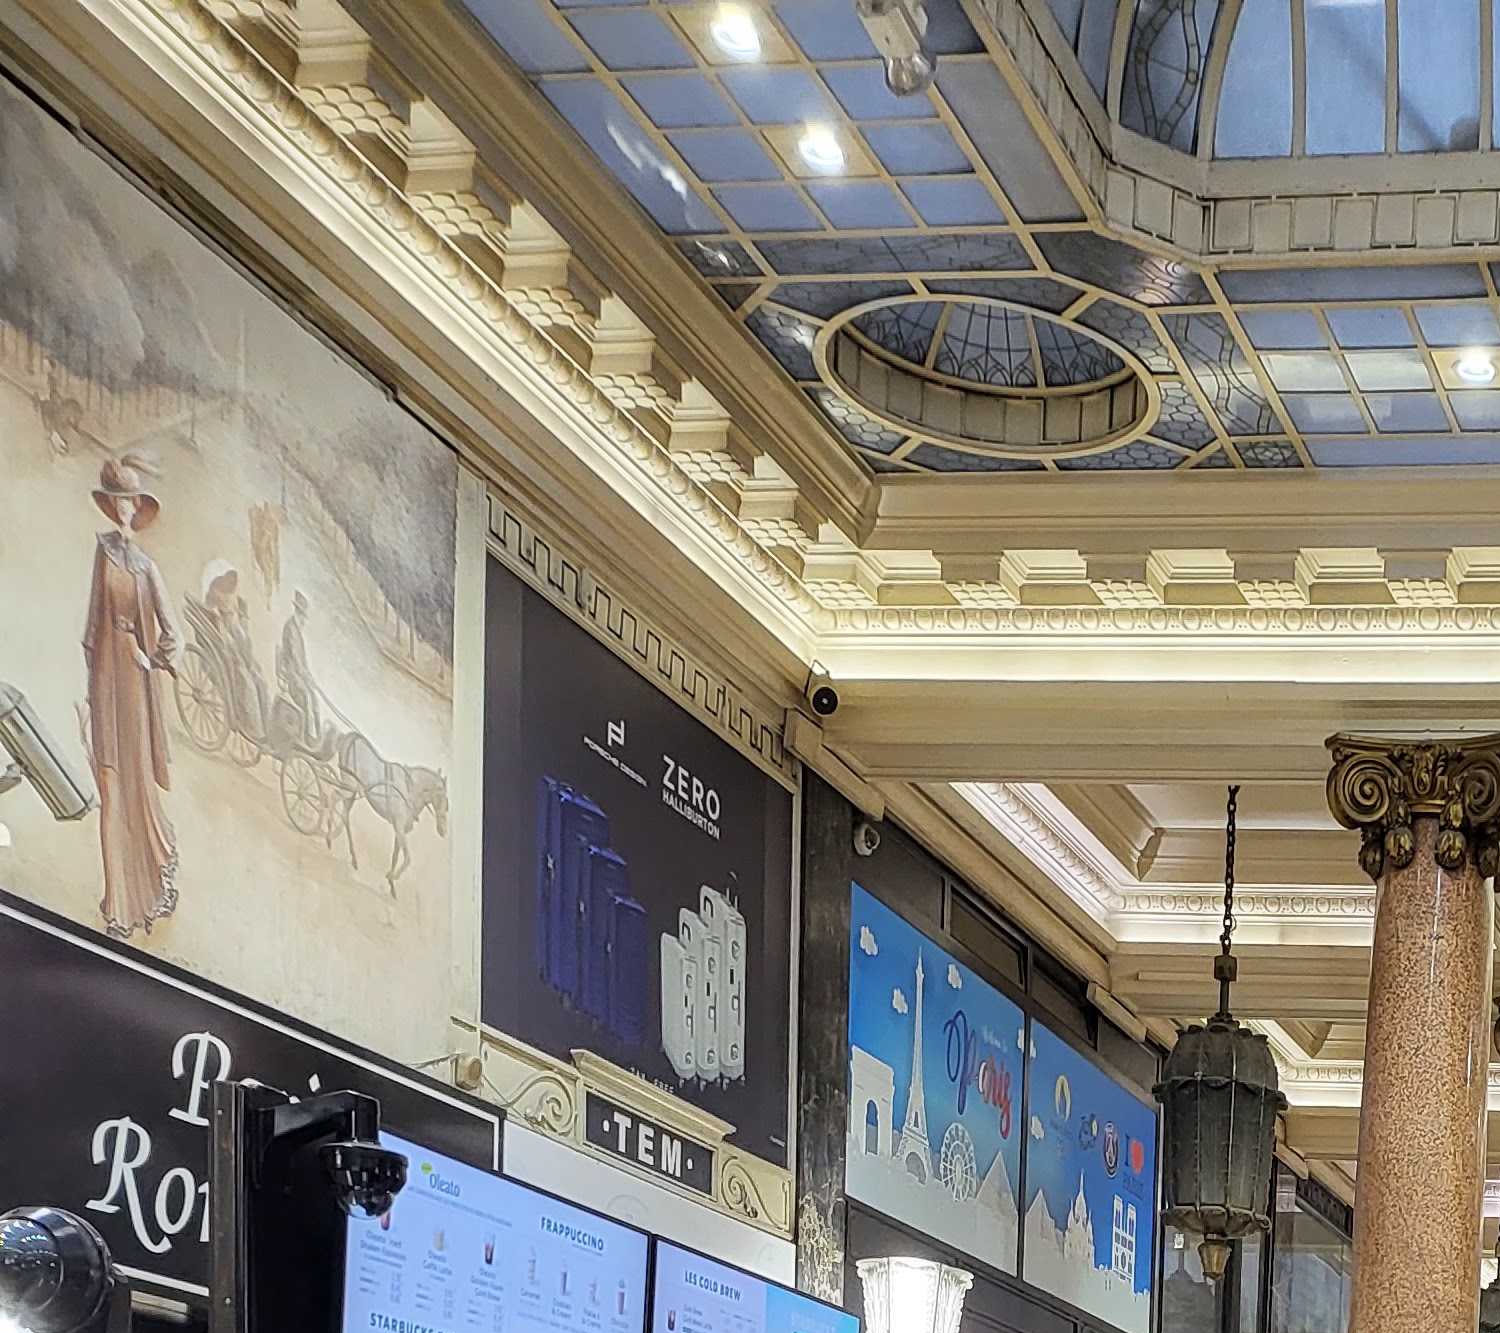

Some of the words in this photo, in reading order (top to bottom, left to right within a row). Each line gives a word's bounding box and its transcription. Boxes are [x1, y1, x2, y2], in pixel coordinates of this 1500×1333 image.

[663, 754, 720, 820] ZERO
[662, 788, 720, 840] HALLIBURTON
[430, 1174, 460, 1197] Oleato
[541, 1217, 603, 1251] FRAPPUCCINO
[685, 1270, 696, 1285] LES
[700, 1277, 717, 1292] COLD
[720, 1284, 740, 1301] BREW
